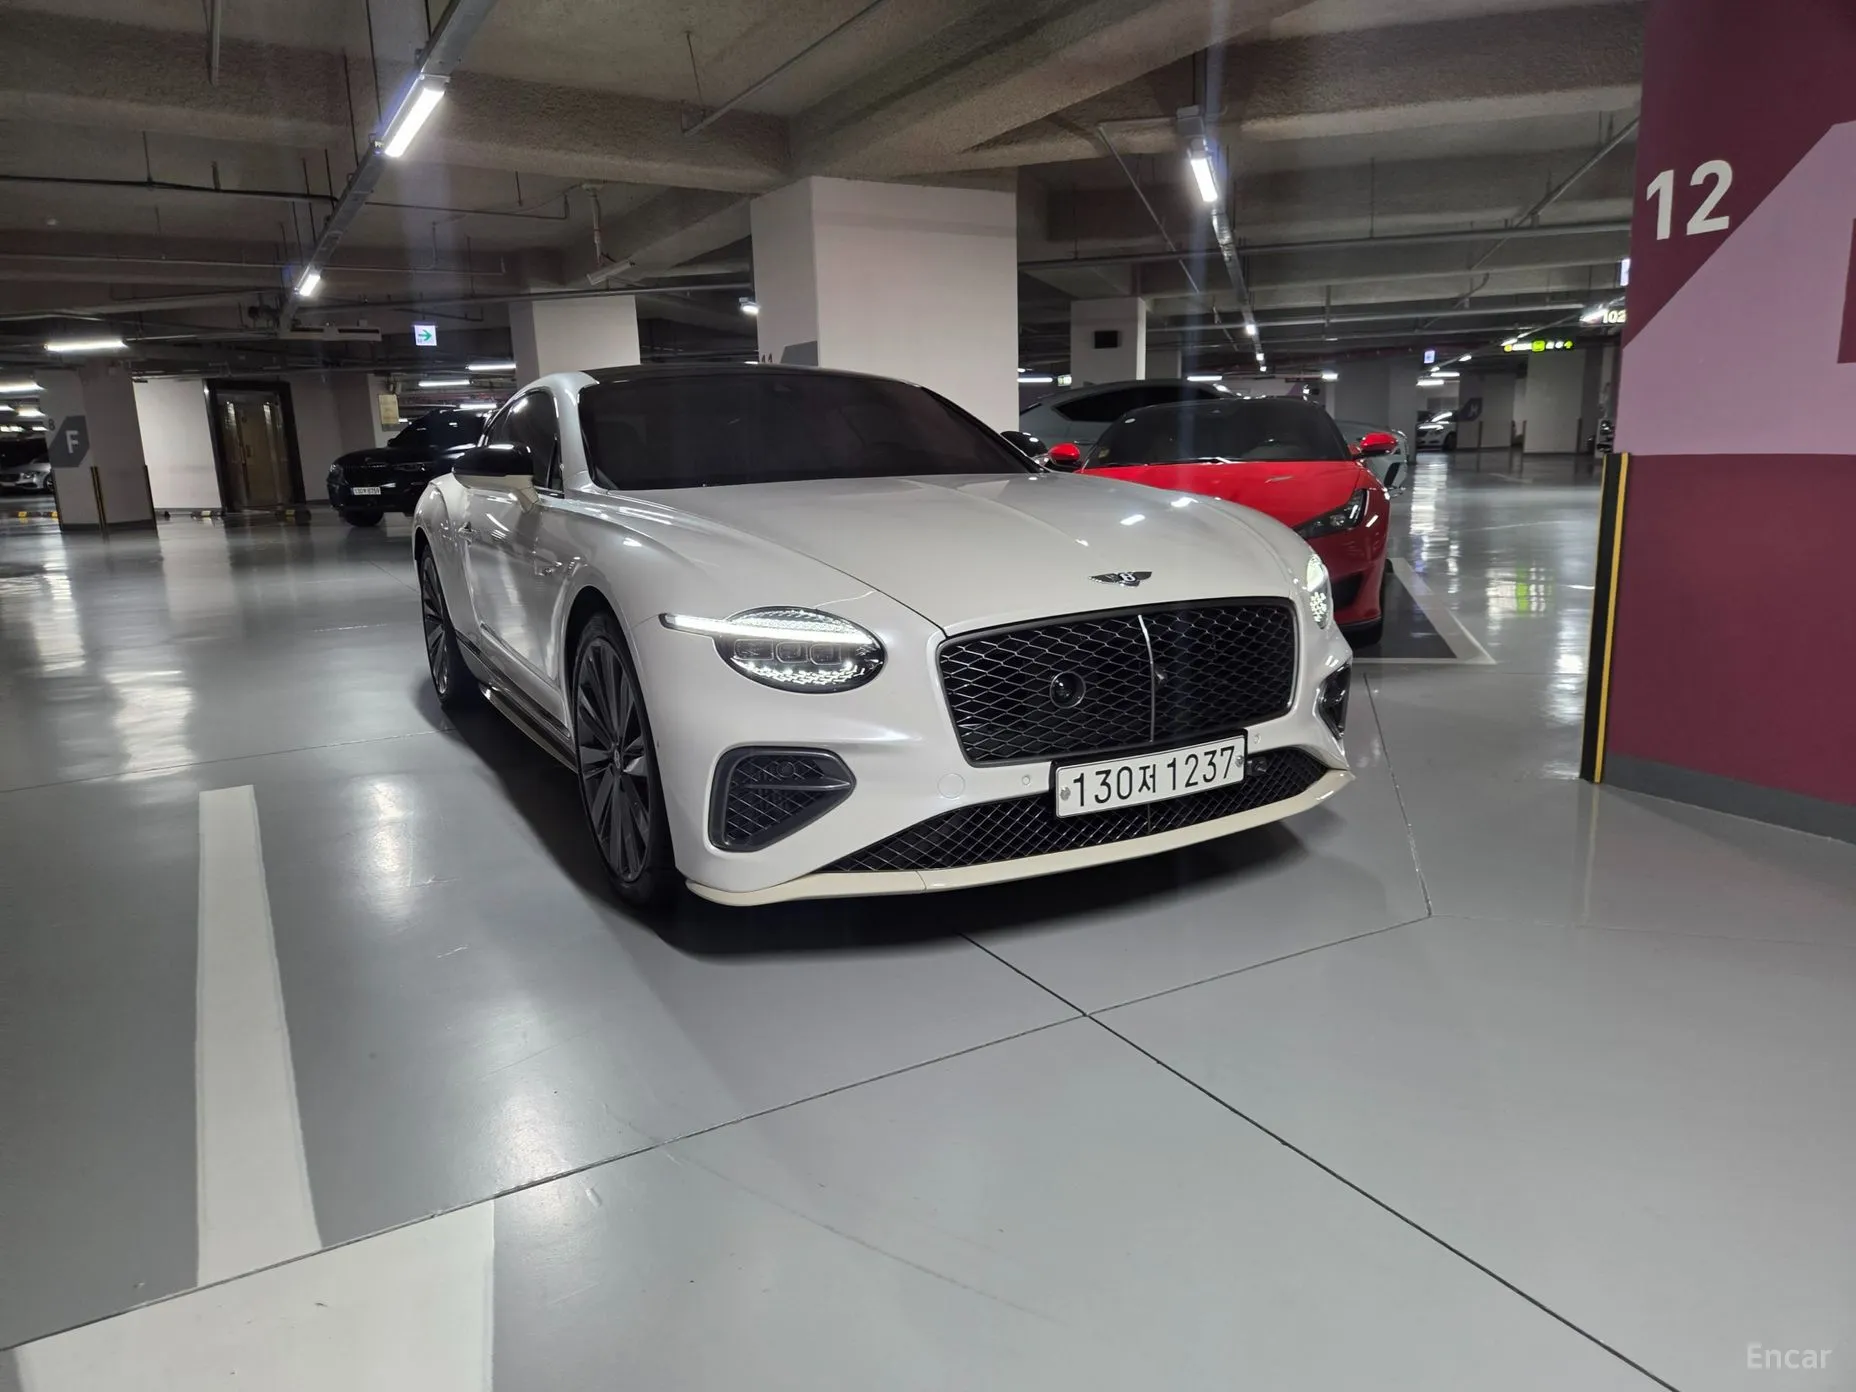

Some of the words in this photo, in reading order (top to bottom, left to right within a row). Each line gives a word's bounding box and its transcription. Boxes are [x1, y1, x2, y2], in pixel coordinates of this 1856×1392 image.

[1646, 159, 1733, 240] 12
[66, 430, 79, 454] F
[1073, 763, 1156, 807] 130저
[1167, 746, 1235, 791] 1237
